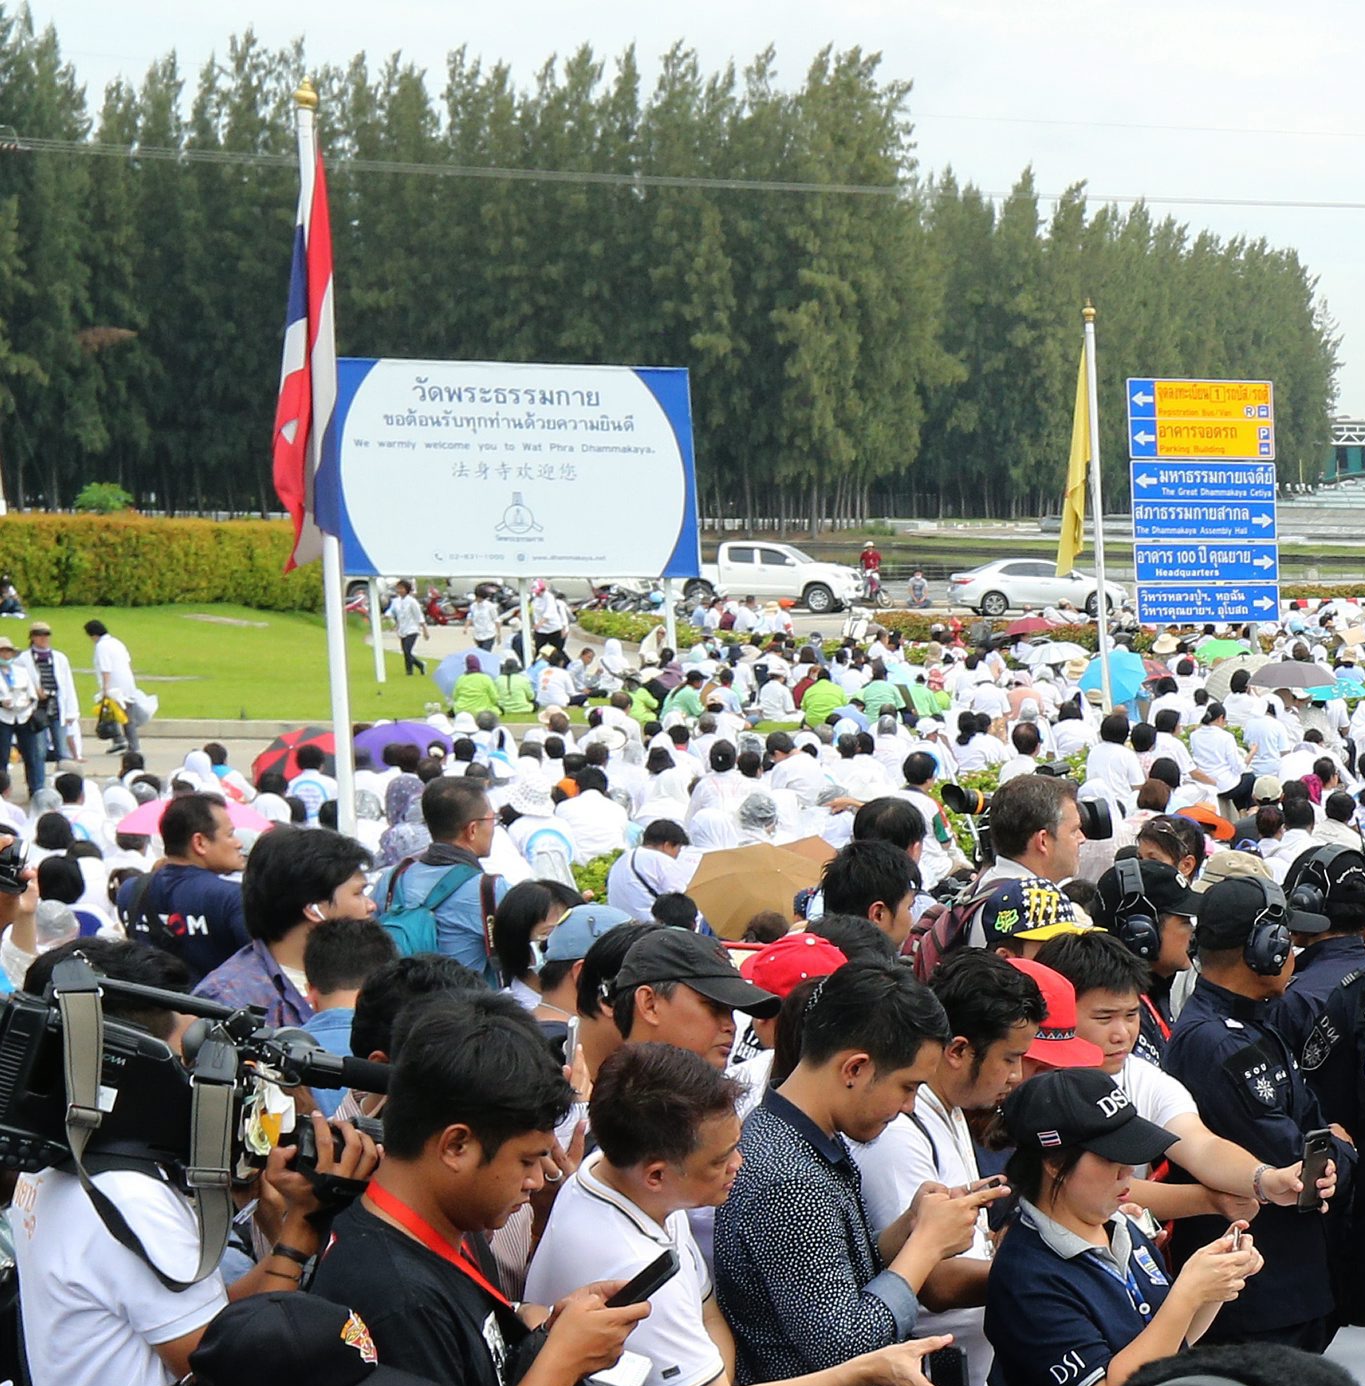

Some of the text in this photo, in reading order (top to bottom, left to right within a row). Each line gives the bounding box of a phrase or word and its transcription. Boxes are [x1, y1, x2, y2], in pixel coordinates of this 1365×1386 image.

[412, 375, 600, 406] วัดพระธรรมกาย
[383, 407, 634, 434] ขอต้อนรับทุกท่านด้วยความยินดี
[1158, 425, 1268, 439] อาคารจอดรถ P
[353, 438, 370, 448] We
[378, 440, 416, 451] warmly
[424, 440, 470, 451] welcome
[478, 443, 497, 453] you
[504, 442, 515, 451] to
[522, 442, 543, 452] Wat
[550, 443, 574, 452] Phra
[1159, 445, 1226, 454] Parking Building
[1159, 467, 1274, 485] มหาธรรมกายเจดีย์
[1162, 487, 1272, 498] The Great Dhammakaya Cetiya
[1135, 505, 1250, 520] สภาธรรมกายสากล
[1136, 526, 1248, 536] The Dhammakaya Assembly Hall
[1137, 545, 1251, 568] อาคาร 100 ปี คุณยาย
[1155, 568, 1220, 578] Headquarters
[1217, 601, 1249, 619] อุโบสถ
[1050, 1350, 1086, 1385] DSI
